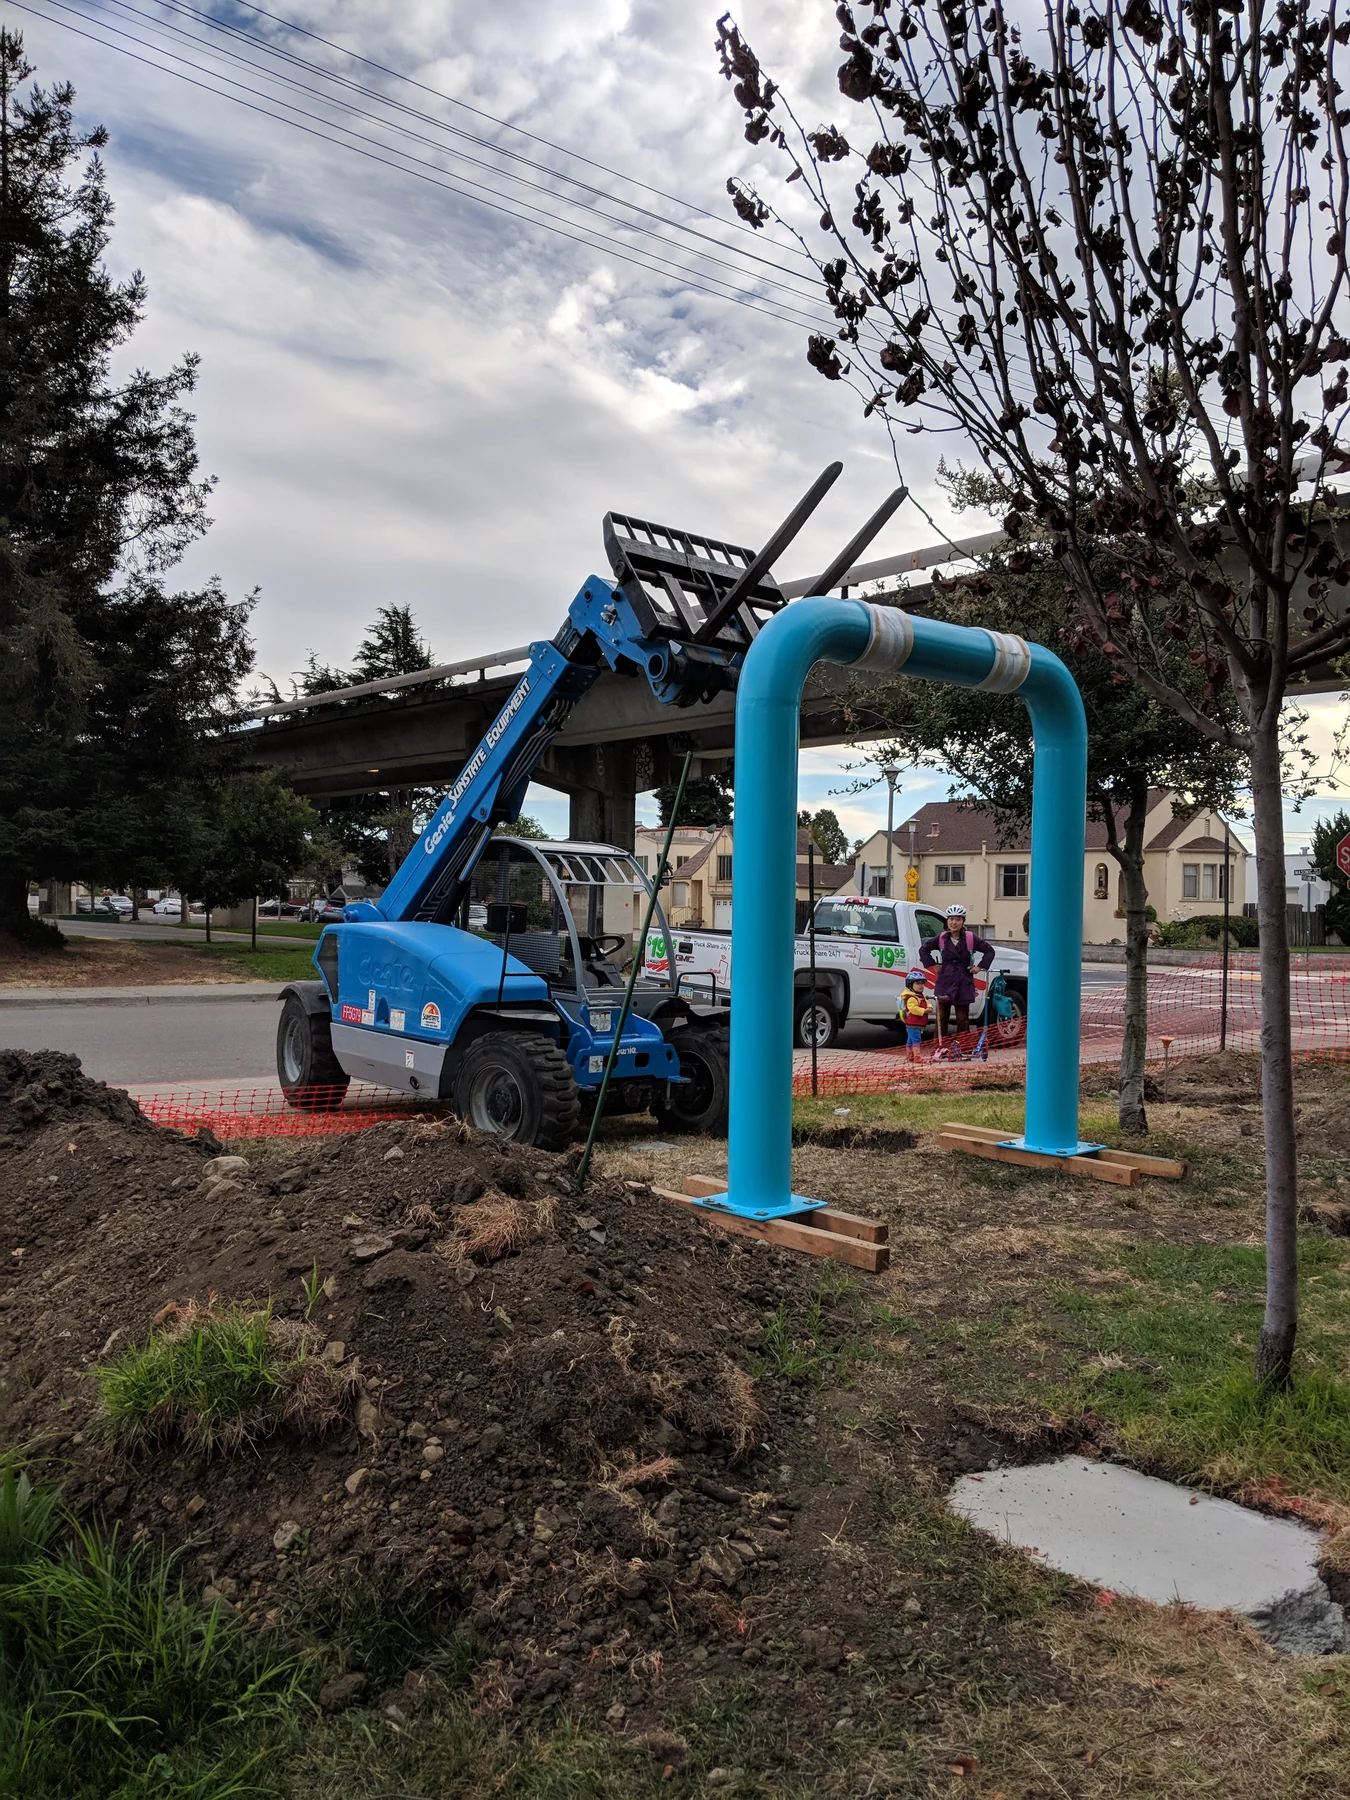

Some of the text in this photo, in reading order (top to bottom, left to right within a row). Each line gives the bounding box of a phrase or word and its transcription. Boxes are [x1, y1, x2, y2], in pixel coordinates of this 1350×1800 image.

[447, 678, 532, 810] SUNSTATE EQUIPMENT
[424, 811, 455, 854] Genie
[832, 903, 848, 912] Need
[853, 905, 877, 914] Pickup?
[676, 955, 694, 963] GMC
